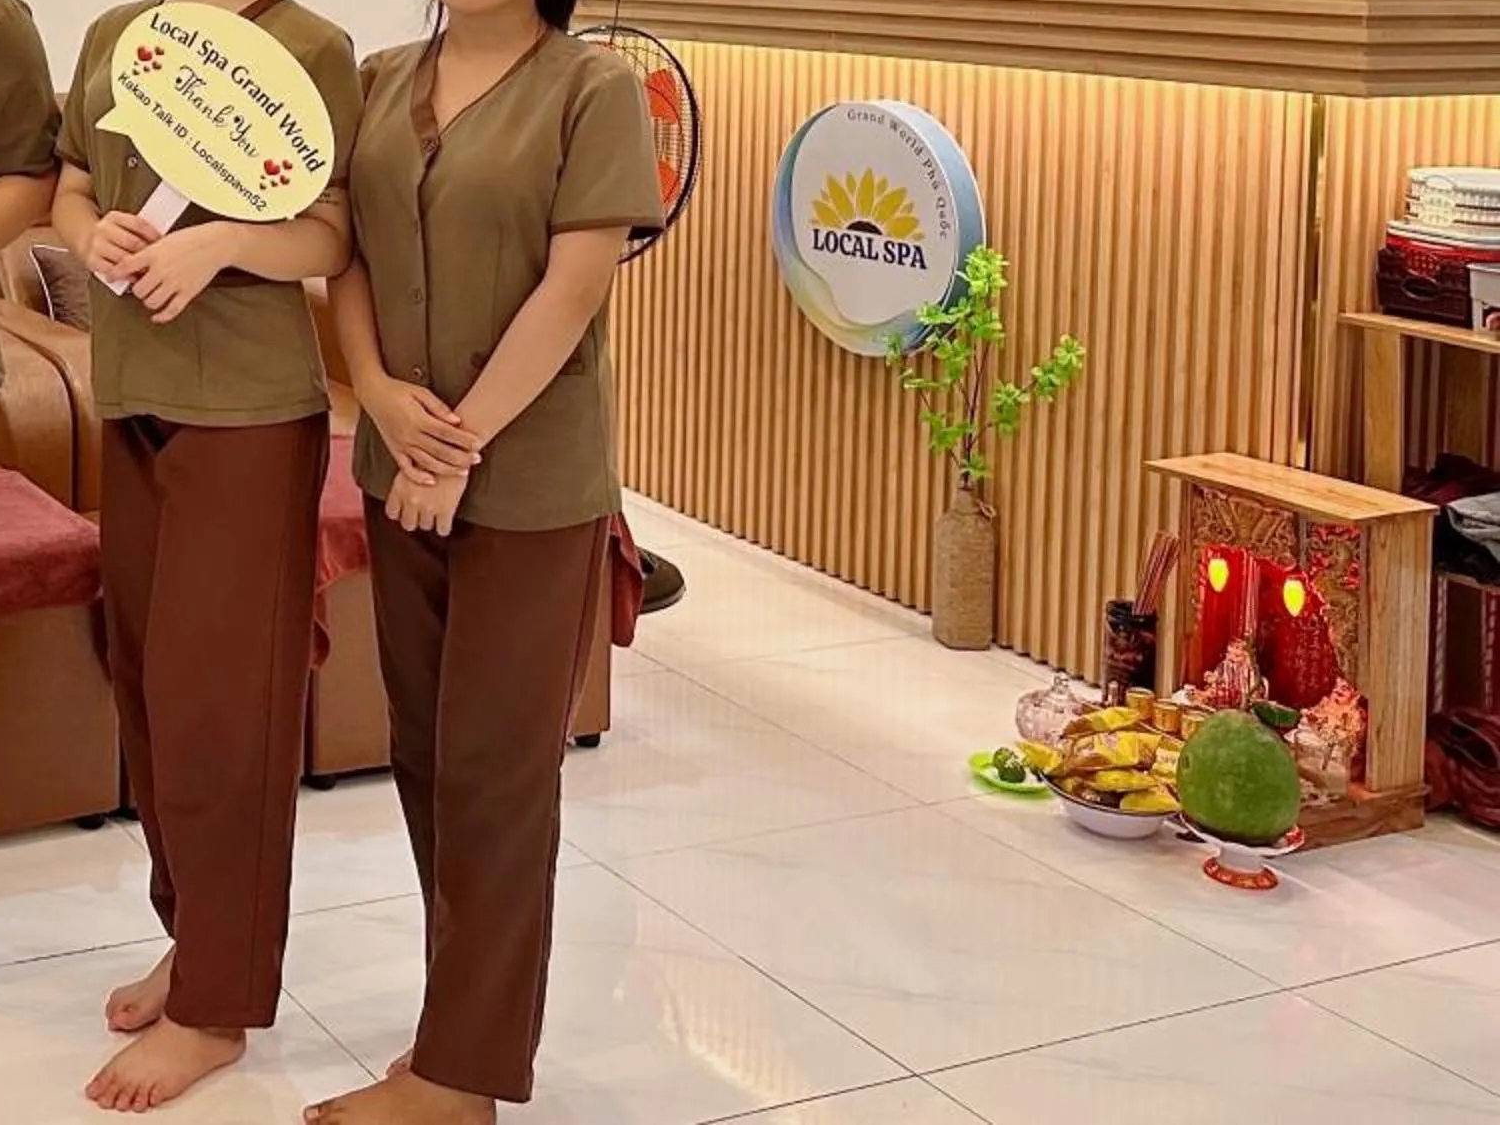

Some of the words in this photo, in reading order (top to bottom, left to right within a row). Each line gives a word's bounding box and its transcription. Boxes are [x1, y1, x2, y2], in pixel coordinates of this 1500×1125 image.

[150, 13, 198, 49] Local
[197, 39, 229, 71] Spa
[231, 65, 284, 118] Grand
[278, 113, 327, 173] World
[175, 64, 235, 128] Thank
[229, 115, 261, 158] You
[847, 109, 885, 124] Grand
[890, 120, 923, 156] World
[117, 72, 152, 107] Kakao
[151, 102, 175, 129] Talk
[173, 123, 189, 139] ID
[192, 140, 268, 212] Localspavn52
[812, 228, 879, 260] LOCAL
[883, 240, 927, 270] SPA
